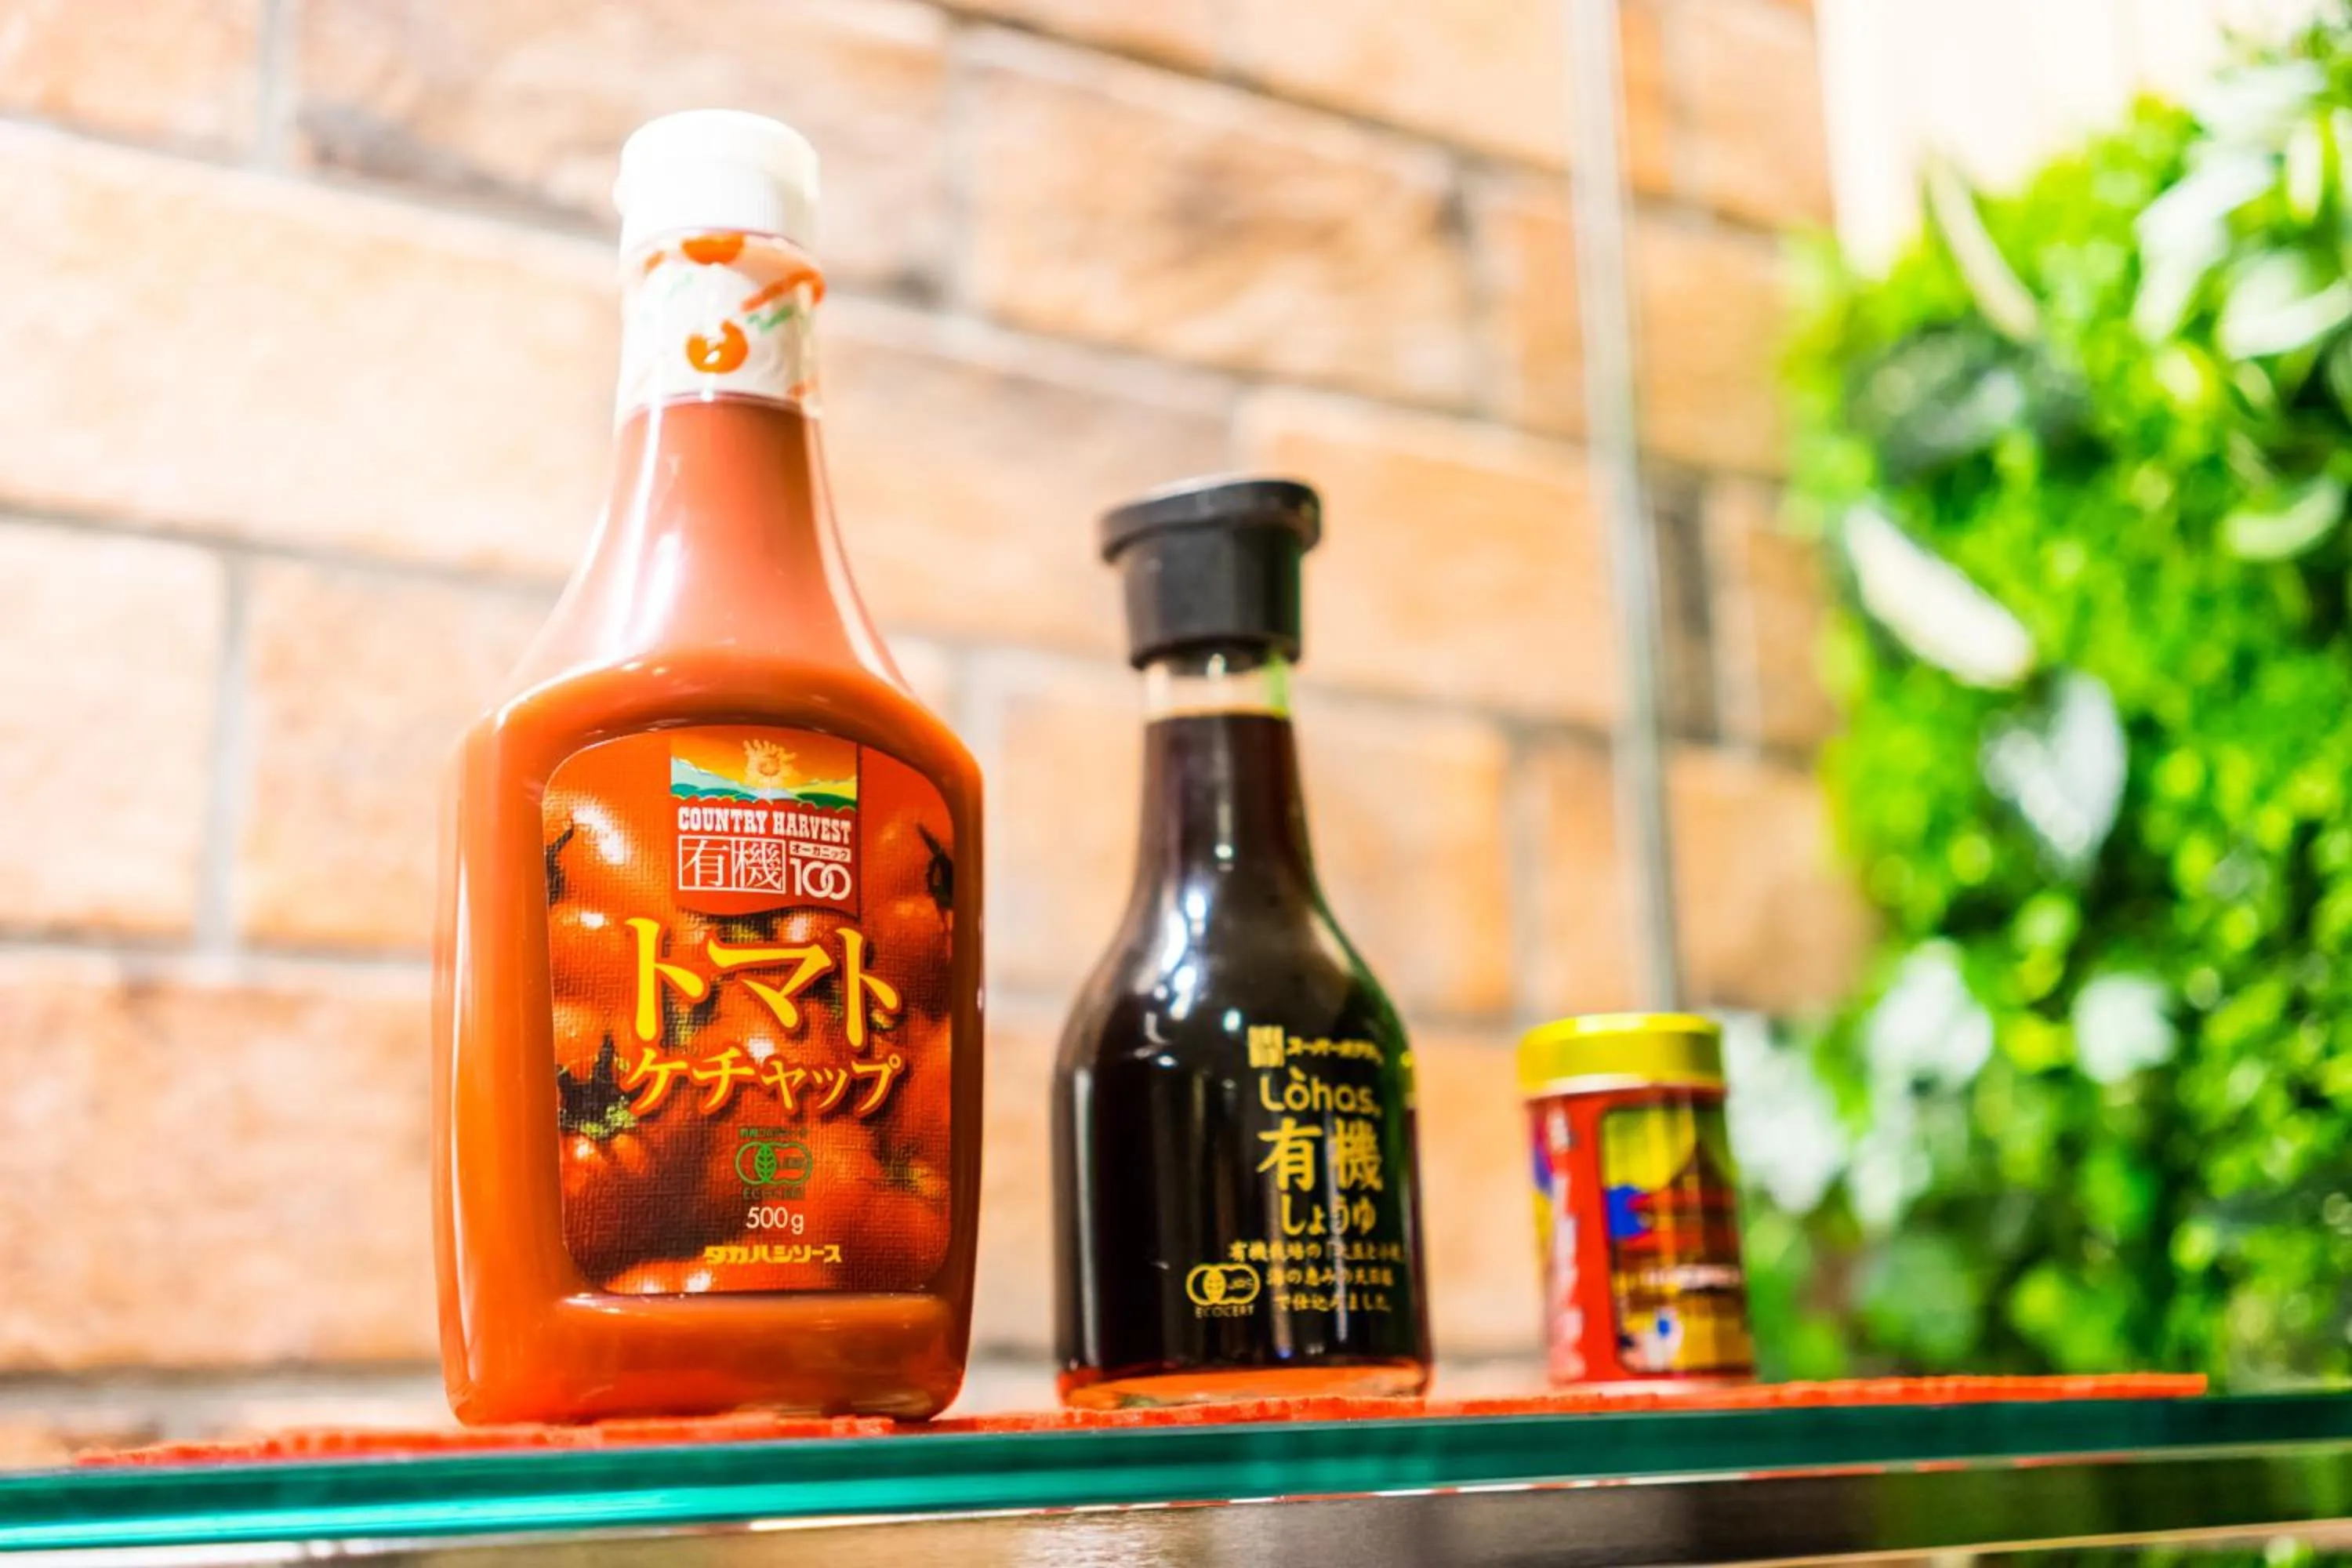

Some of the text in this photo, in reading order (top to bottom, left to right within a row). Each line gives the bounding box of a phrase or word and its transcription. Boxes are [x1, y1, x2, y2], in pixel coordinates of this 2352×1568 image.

[678, 806, 852, 844] COUNTRY HARVEST
[682, 839, 782, 891] 有機
[791, 843, 849, 861] オーガニック
[789, 857, 852, 901] 100
[624, 917, 899, 1047] トマト
[627, 1047, 901, 1111] ケチャップ
[1257, 1117, 1383, 1192] 有機
[1281, 1195, 1377, 1236] しょうゆ
[704, 1243, 842, 1265] タカハシソース
